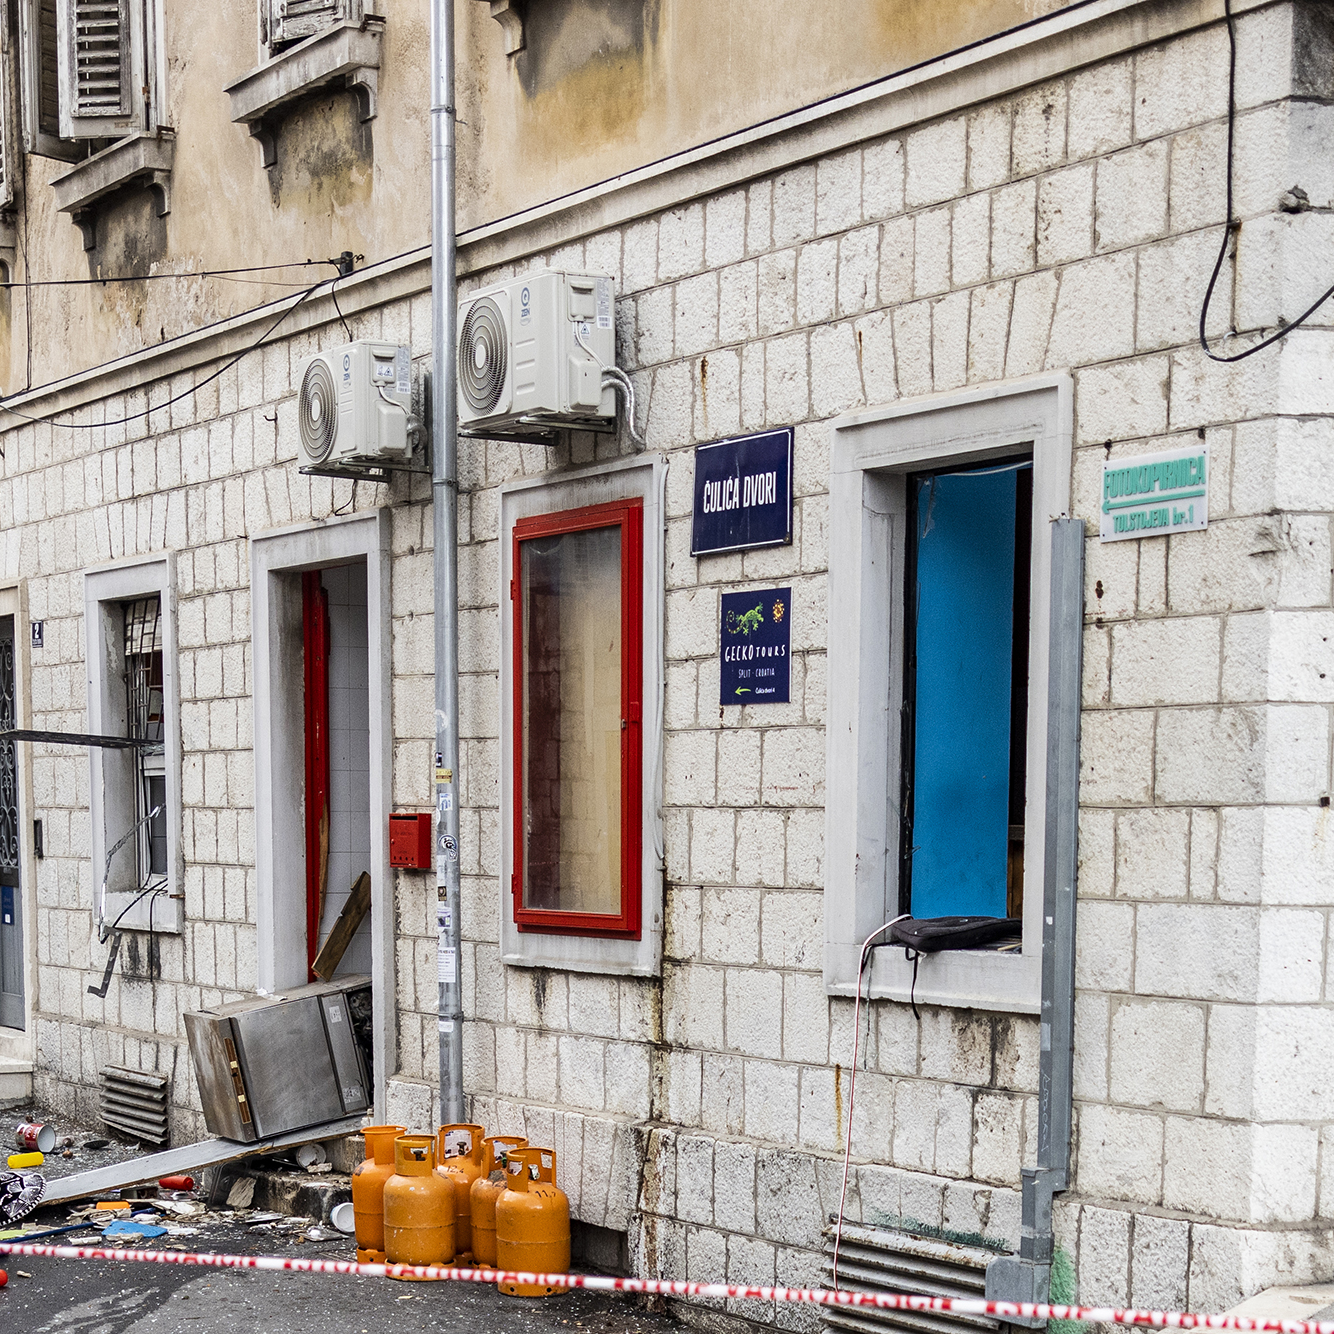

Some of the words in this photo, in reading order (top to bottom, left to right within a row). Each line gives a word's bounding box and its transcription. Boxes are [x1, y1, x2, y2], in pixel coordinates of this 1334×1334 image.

[1103, 456, 1206, 500] FOTOKOPIRNICA
[703, 475, 740, 514] ČULIĆA
[743, 471, 777, 508] DVORI
[1113, 507, 1170, 533] TOLSTOJEVA
[34, 623, 40, 639] 2
[724, 645, 754, 662] GECKO
[756, 644, 786, 658] TOURS
[738, 668, 751, 679] SPLIT
[755, 667, 775, 678] CROATIA
